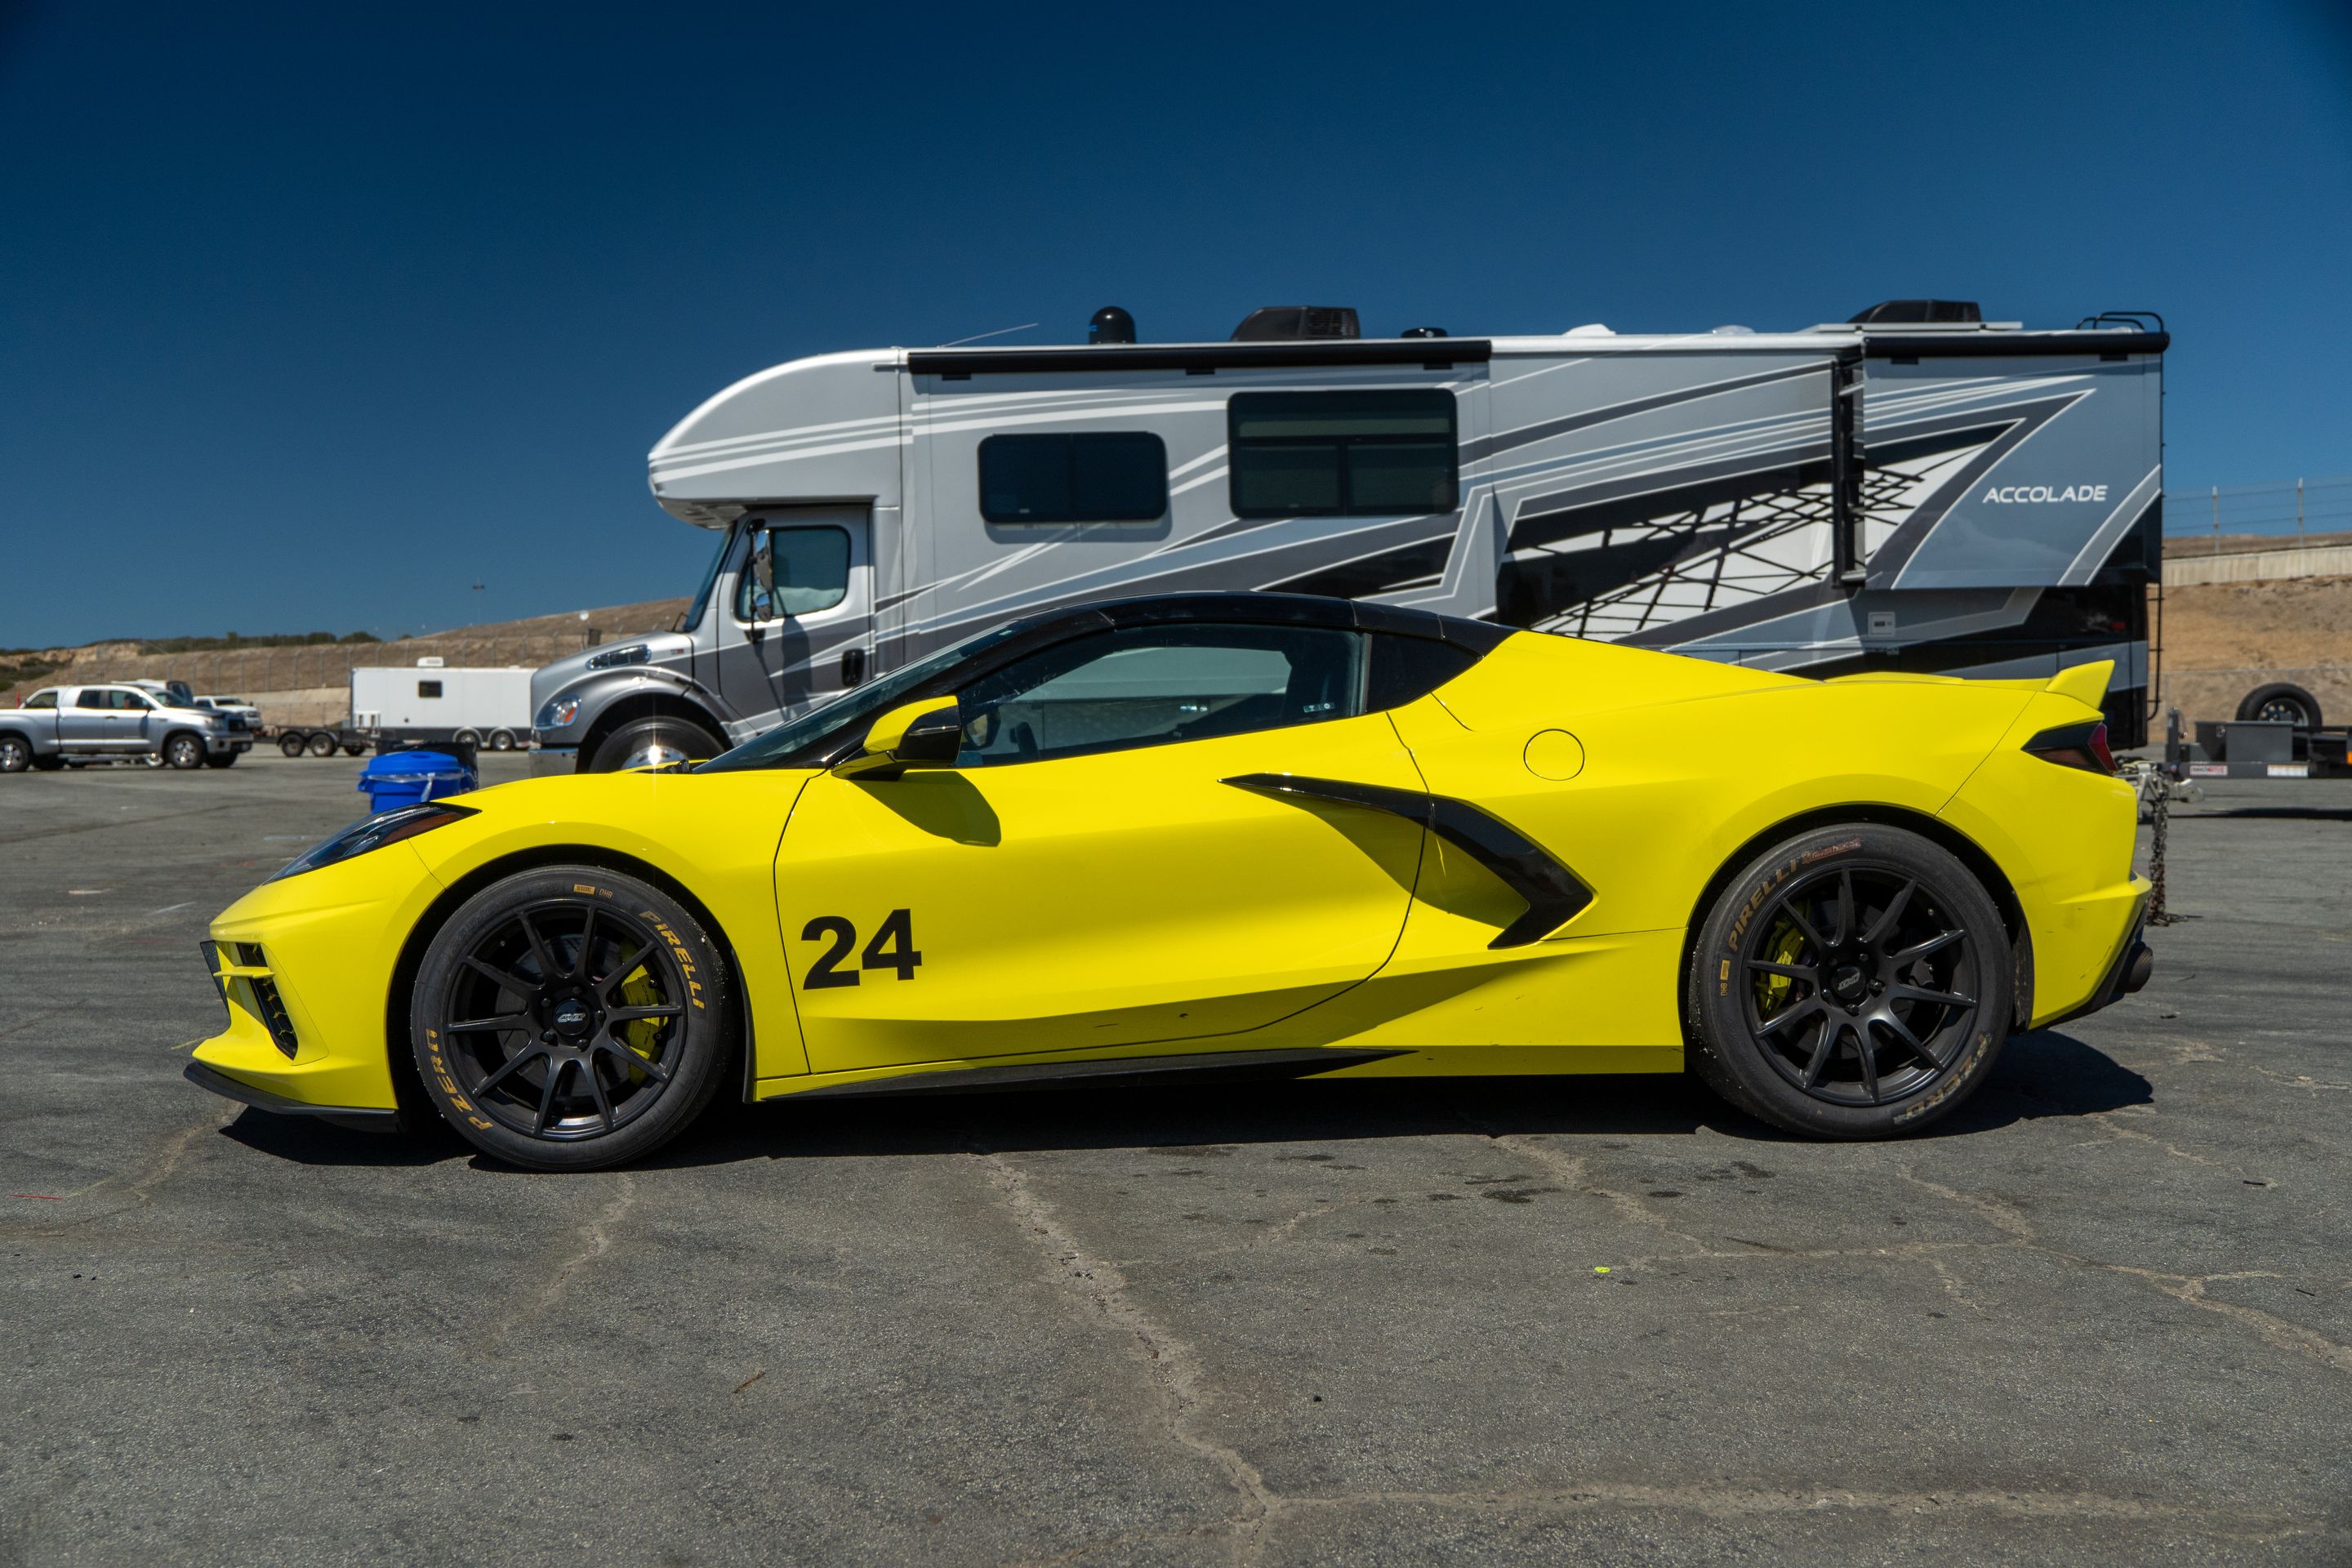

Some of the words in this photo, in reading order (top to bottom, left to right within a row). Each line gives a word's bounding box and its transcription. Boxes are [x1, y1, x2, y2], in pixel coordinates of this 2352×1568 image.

[1982, 485, 2109, 504] ACCOLADE
[599, 888, 613, 899] DHB
[1728, 858, 1797, 952] PIRELLI
[639, 910, 706, 1009] PIRELLI
[801, 908, 923, 991] 24
